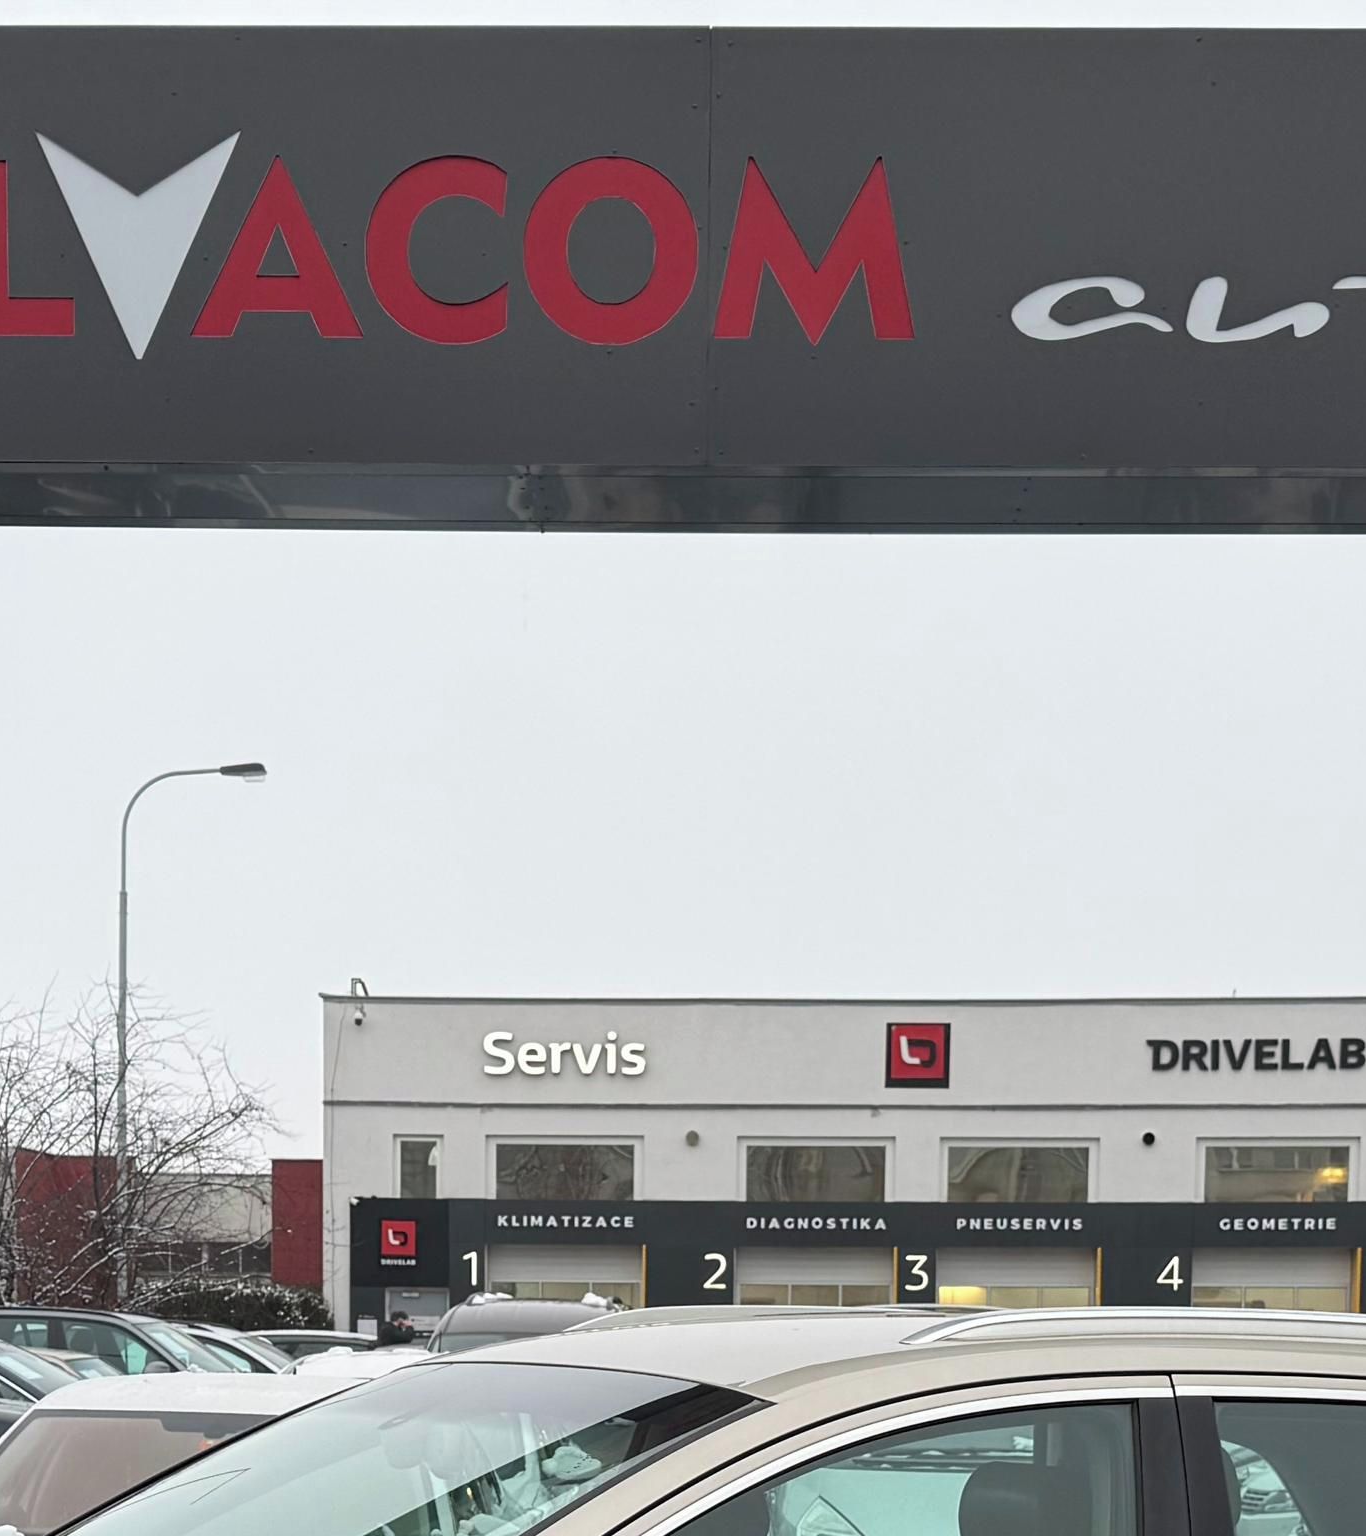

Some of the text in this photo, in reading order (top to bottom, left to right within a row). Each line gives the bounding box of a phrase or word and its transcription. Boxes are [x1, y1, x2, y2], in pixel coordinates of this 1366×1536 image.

[482, 1031, 647, 1076] Servis
[1146, 1038, 1366, 1072] DRIVELAB
[496, 1214, 635, 1229] KLIMATIZACE
[745, 1216, 887, 1231] DIAGNOSTIKA
[955, 1217, 1084, 1232] PNEUSERVIS
[1218, 1216, 1338, 1232] GEOMETRIE
[380, 1258, 416, 1266] DRIVELAB
[461, 1251, 479, 1286] 1
[702, 1253, 727, 1290] 2
[904, 1254, 929, 1291] 3
[1156, 1255, 1184, 1291] 4
